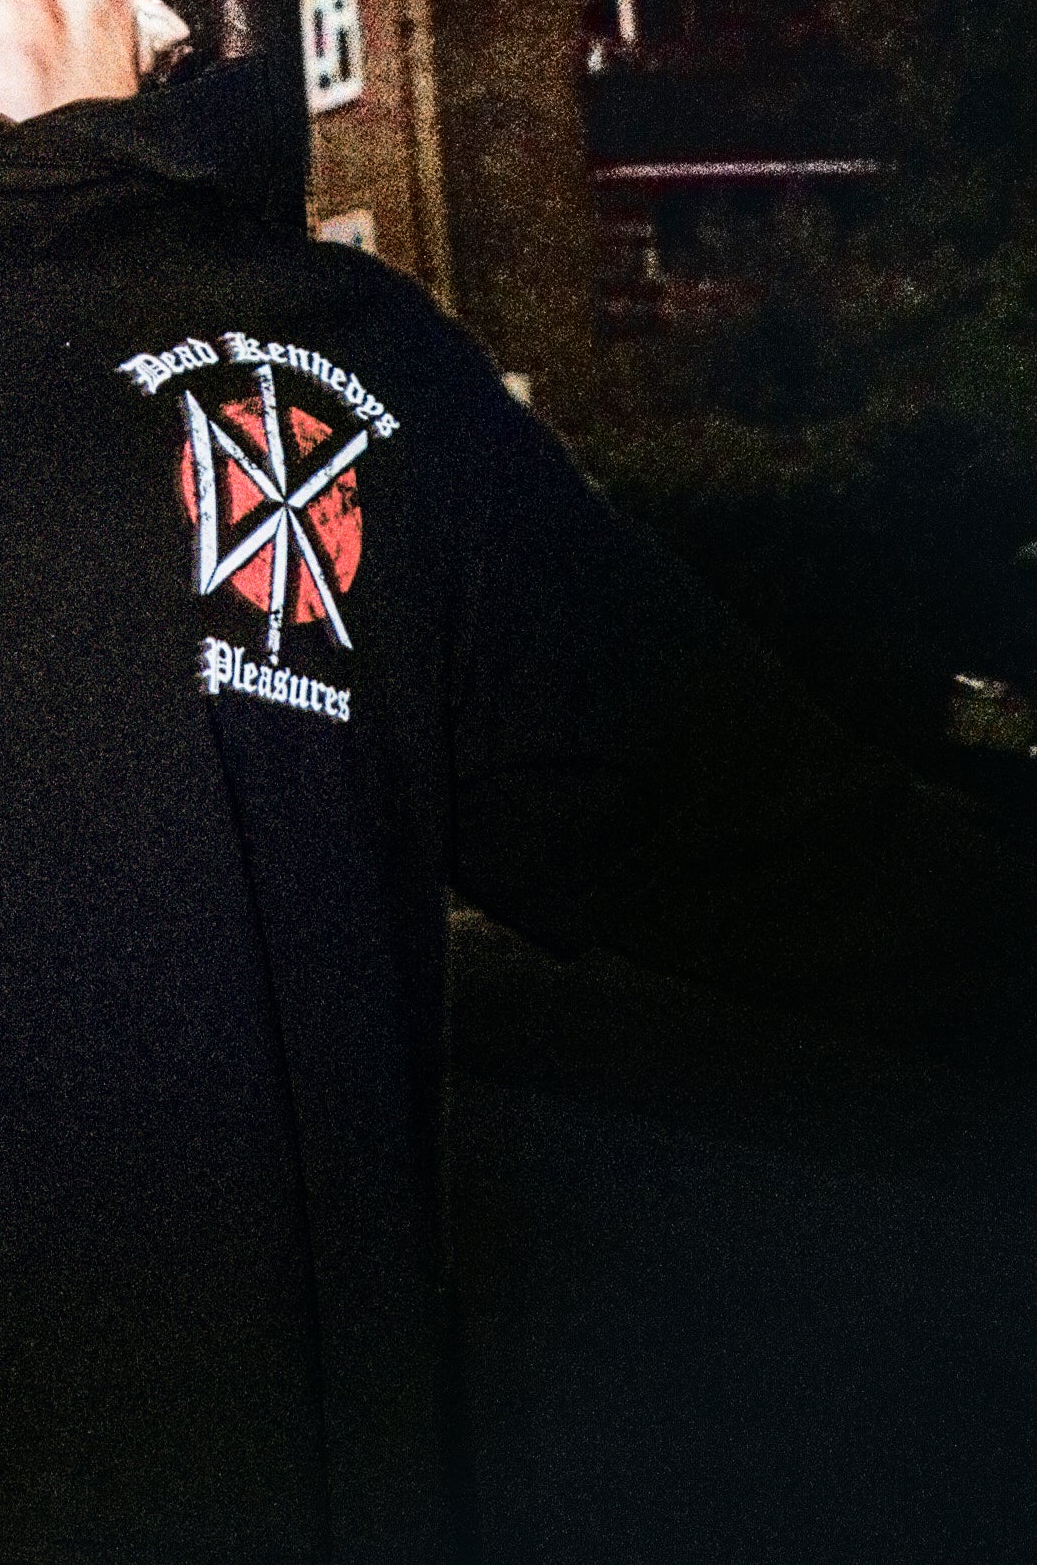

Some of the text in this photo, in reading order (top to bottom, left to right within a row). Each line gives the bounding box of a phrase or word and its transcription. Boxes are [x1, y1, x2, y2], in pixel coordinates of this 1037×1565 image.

[117, 331, 400, 438] Dead Kennedys
[200, 635, 352, 723] Pleasures
